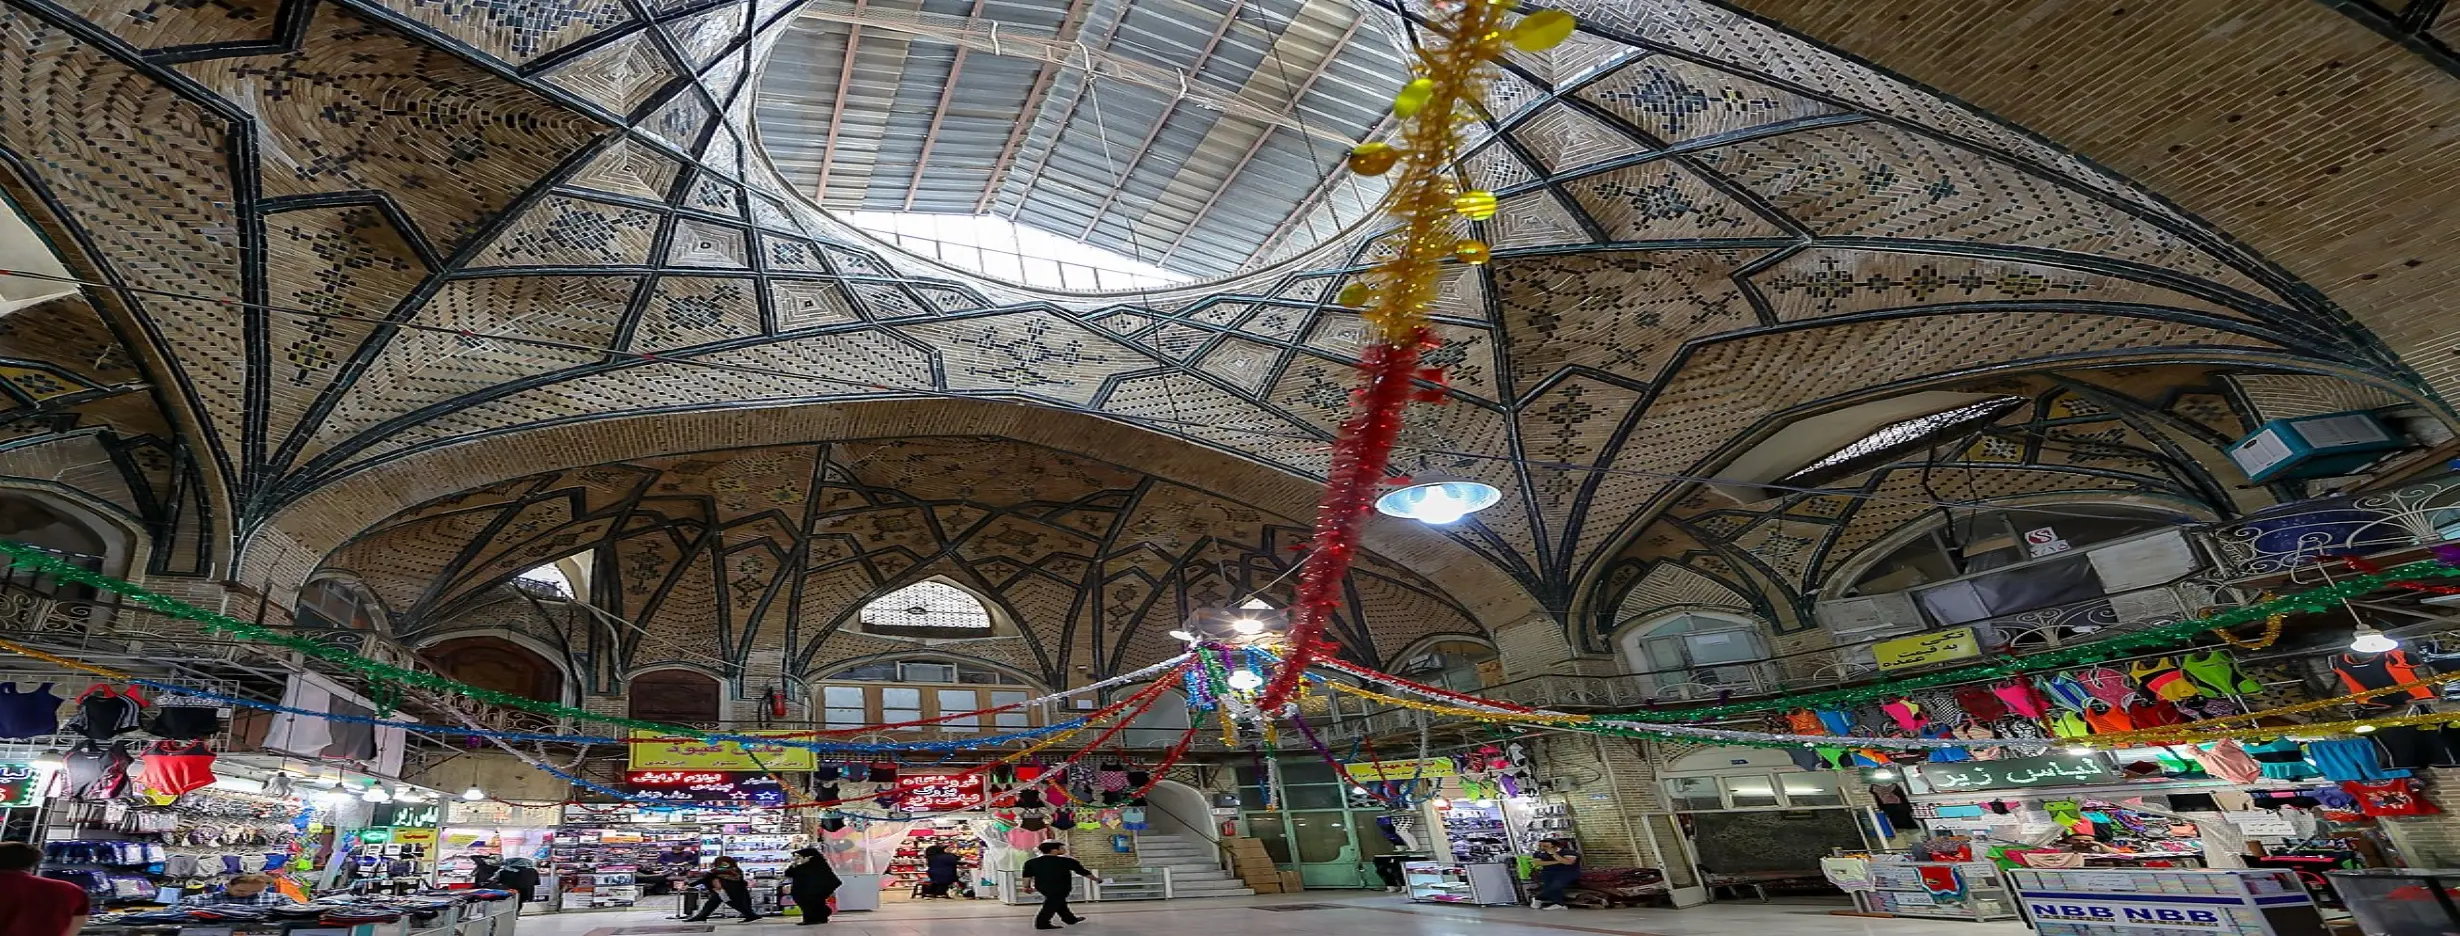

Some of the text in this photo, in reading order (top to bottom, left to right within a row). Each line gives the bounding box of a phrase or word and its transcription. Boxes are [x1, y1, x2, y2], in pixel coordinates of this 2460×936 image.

[1898, 643, 1958, 658] به قیمت
[1882, 656, 1925, 668] عمده
[632, 772, 722, 784] لوازم آرایشی
[1937, 757, 2103, 788] لباس زیر
[902, 775, 980, 788] فروشگاه
[912, 785, 958, 798] بزرگ
[904, 793, 980, 807] لباس زیر
[393, 806, 439, 828] لباس زیر
[2032, 904, 2116, 918] NBB
[2123, 907, 2219, 923] NBB
